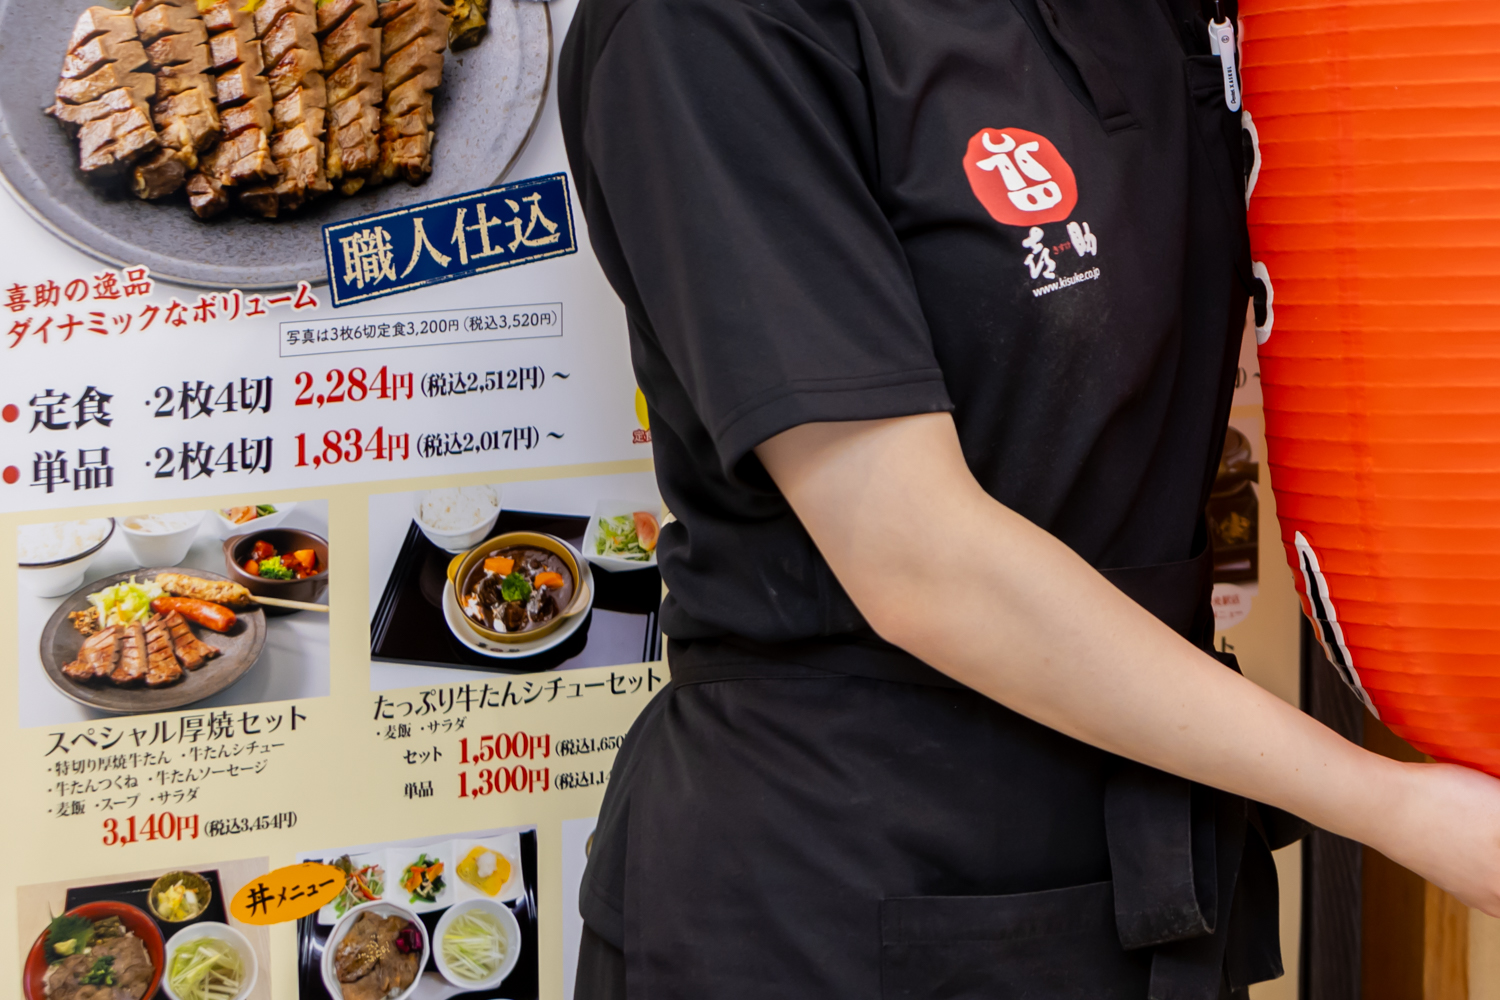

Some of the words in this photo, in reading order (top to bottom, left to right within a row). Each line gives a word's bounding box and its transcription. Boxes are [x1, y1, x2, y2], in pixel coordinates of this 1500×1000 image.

[338, 191, 563, 290] 職人仕込
[4, 267, 152, 313] 喜助の逸品
[1032, 267, 1101, 297] www.kisuke.co.jp
[6, 282, 319, 349] ダイナミックなボリューム
[29, 386, 114, 434] 定食
[293, 365, 415, 408] 2,284円
[420, 365, 546, 399] (税込2,512円)
[29, 446, 114, 494] 単品
[293, 426, 410, 469] 1,834円
[416, 426, 540, 460] (税込2,017円)
[373, 667, 662, 721] たっぷり牛たんシチューセット
[45, 705, 308, 757] スペシャル厚焼セット
[403, 745, 443, 765] セット
[458, 731, 551, 765] 1,500円
[555, 733, 628, 757] (税込1,650
[404, 780, 434, 799] 単品
[457, 765, 550, 799] 1,300円
[102, 811, 199, 847] 3,140円
[204, 811, 298, 838] (税込3,454円)
[245, 879, 335, 917] 丼メニュー
